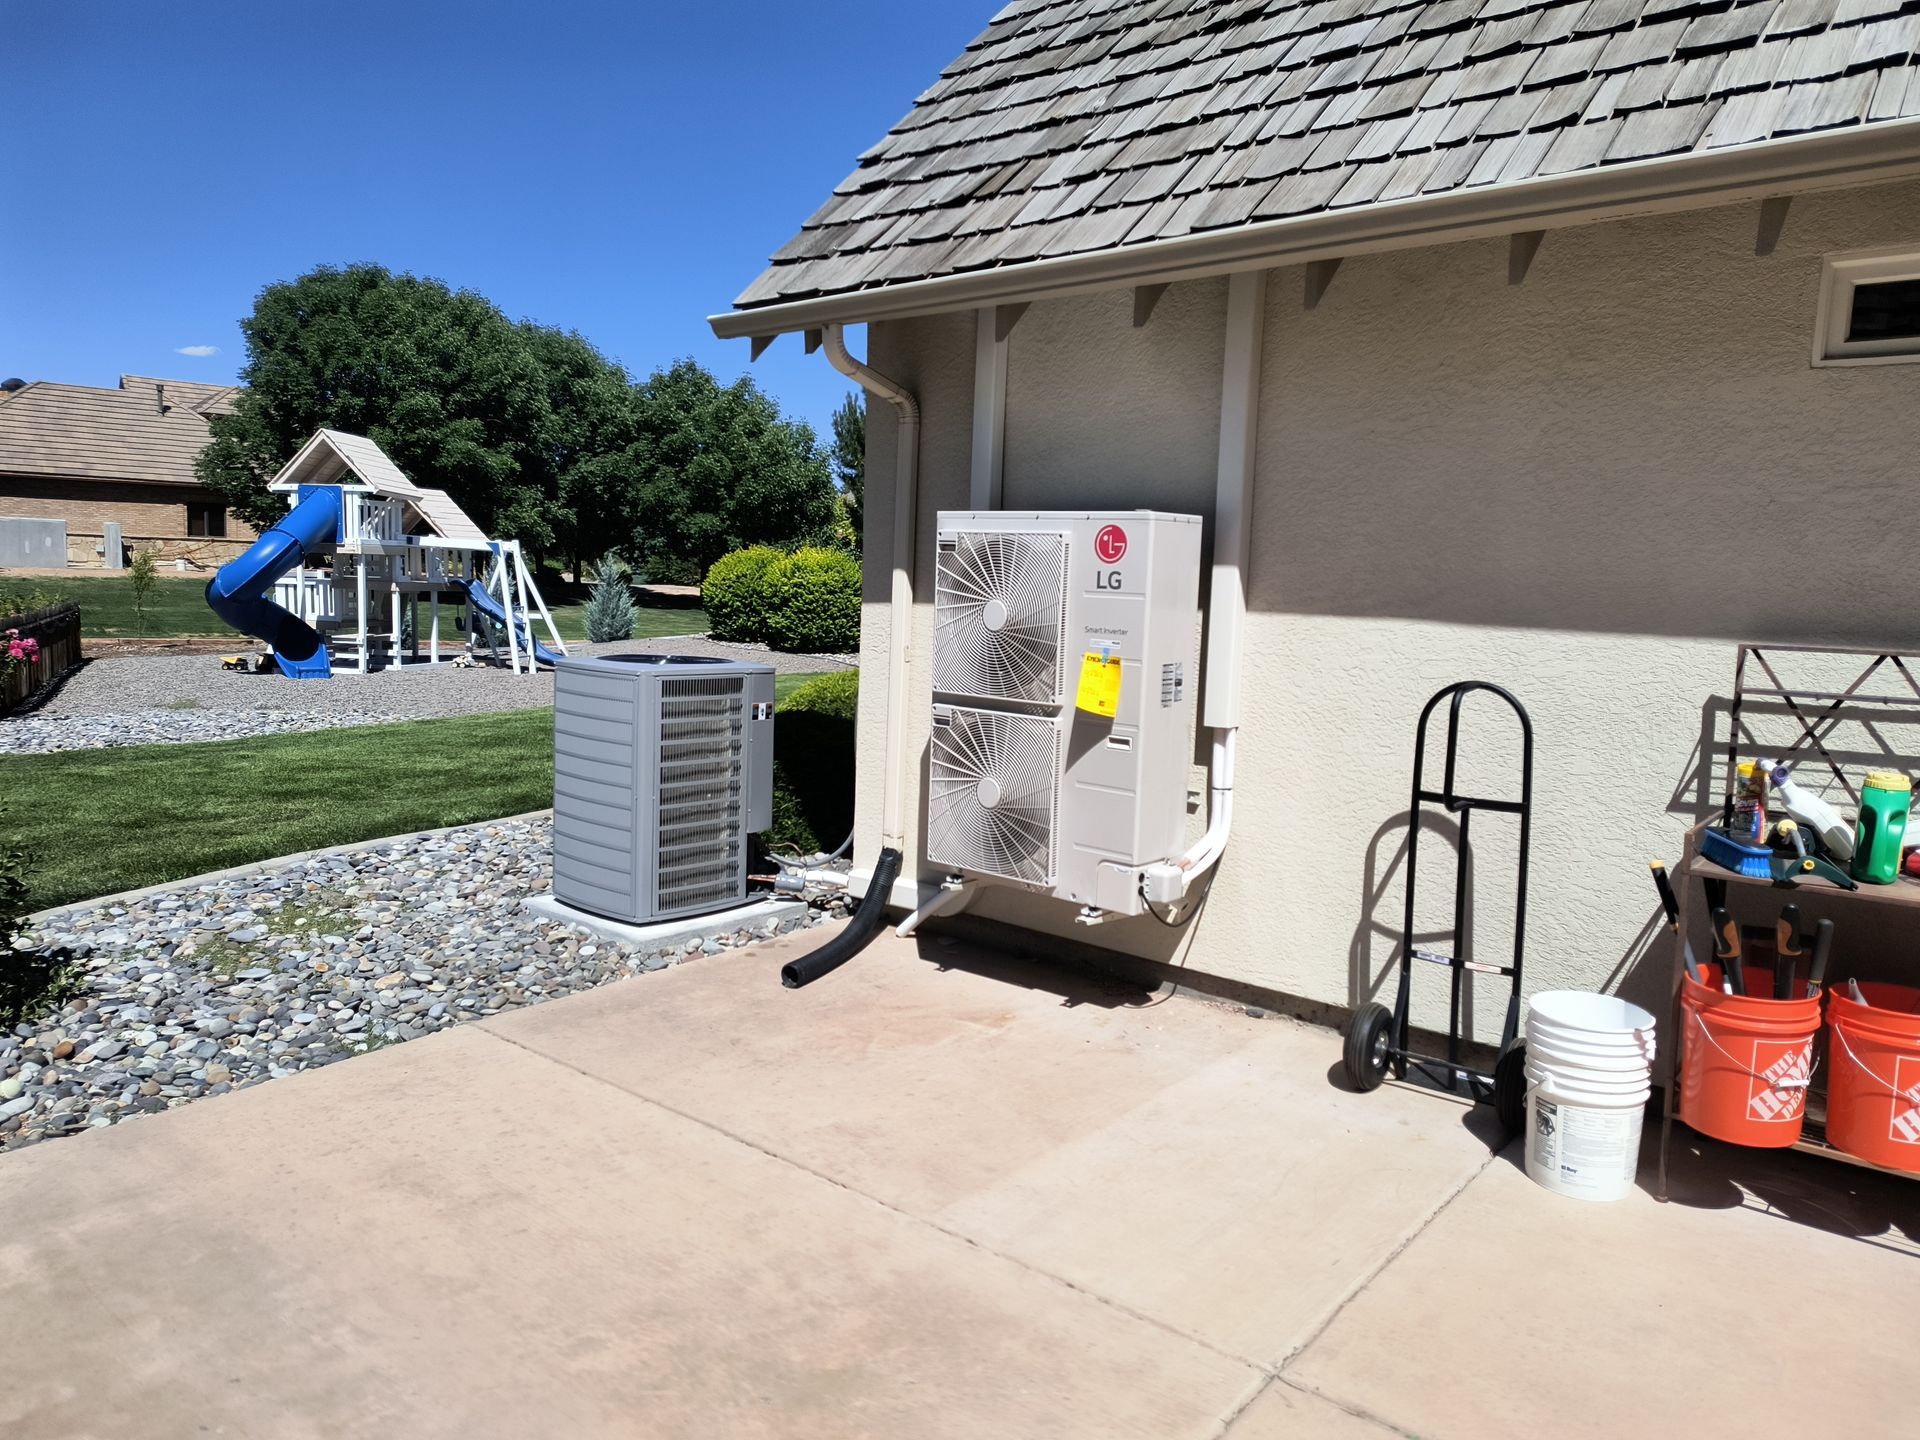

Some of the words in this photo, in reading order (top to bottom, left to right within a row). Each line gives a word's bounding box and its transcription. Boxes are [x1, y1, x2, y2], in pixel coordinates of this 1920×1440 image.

[1097, 571, 1122, 590] LG
[1085, 625, 1103, 634] Smart
[1104, 627, 1129, 635] Inverter
[1761, 1050, 1798, 1084] THE
